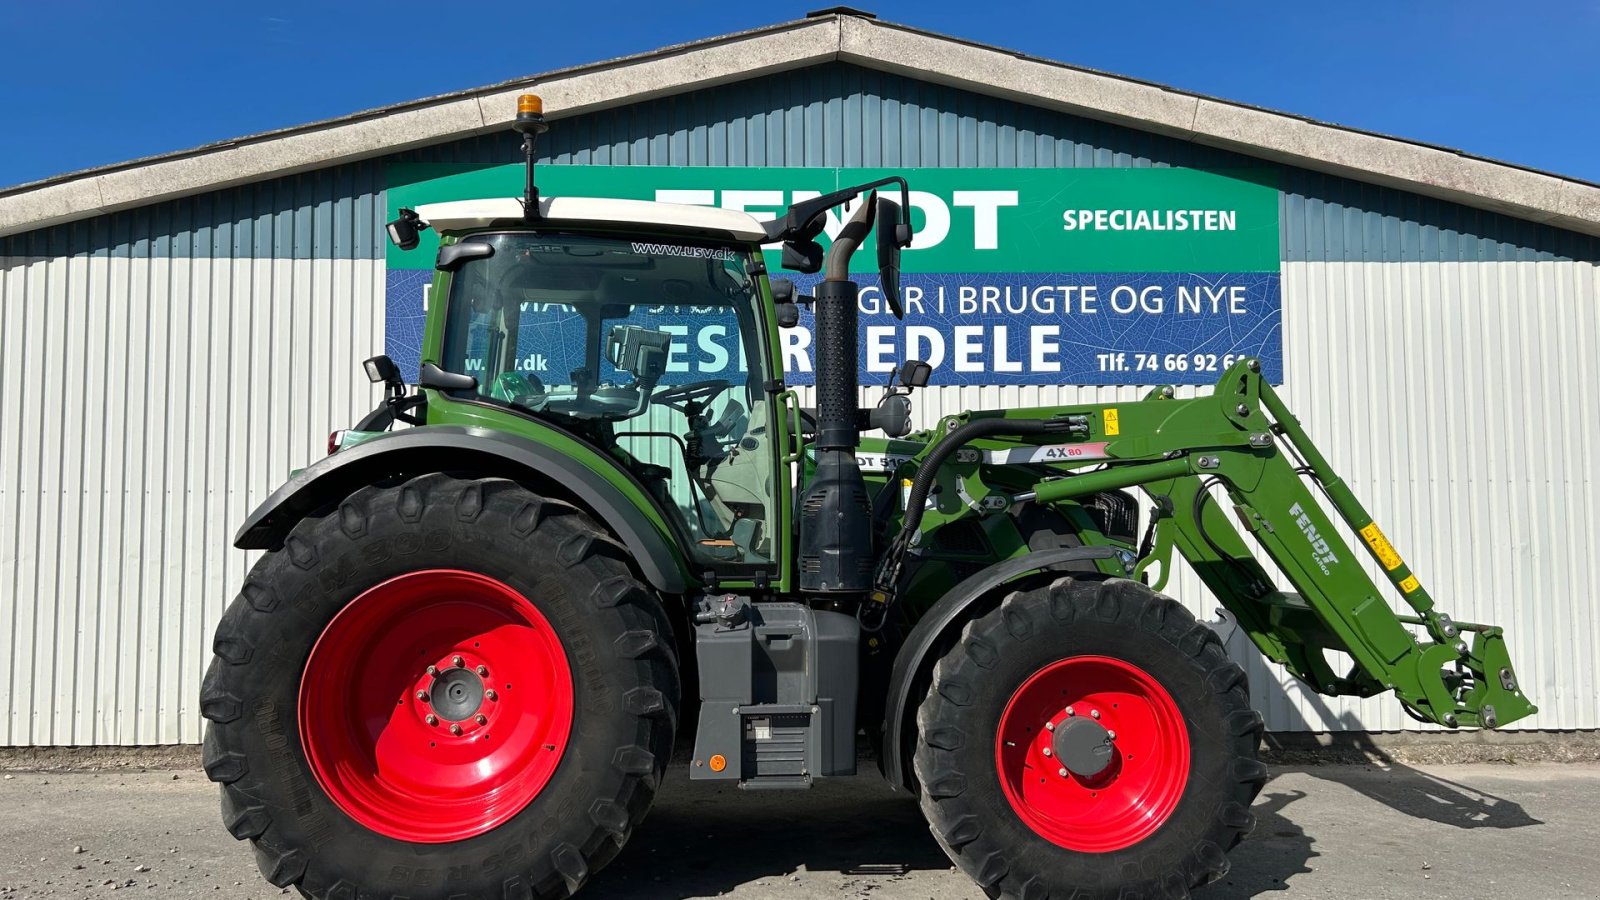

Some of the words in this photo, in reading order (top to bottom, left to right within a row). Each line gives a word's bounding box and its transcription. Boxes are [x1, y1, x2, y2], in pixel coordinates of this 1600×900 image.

[655, 189, 1020, 251] NDT
[1062, 209, 1237, 231] SPECIALISTEN
[631, 242, 736, 262] www.usv.dk
[938, 286, 945, 314] I
[958, 285, 1098, 314] BRUGTE
[1110, 285, 1165, 314] OG
[1177, 286, 1247, 314] NYE
[1096, 352, 1130, 372] Tlf.
[1135, 353, 1159, 372] 74
[1164, 353, 1189, 372] 66
[1193, 353, 1218, 372] 92
[1288, 501, 1340, 564] FENDT
[1311, 552, 1330, 576] CARGO
